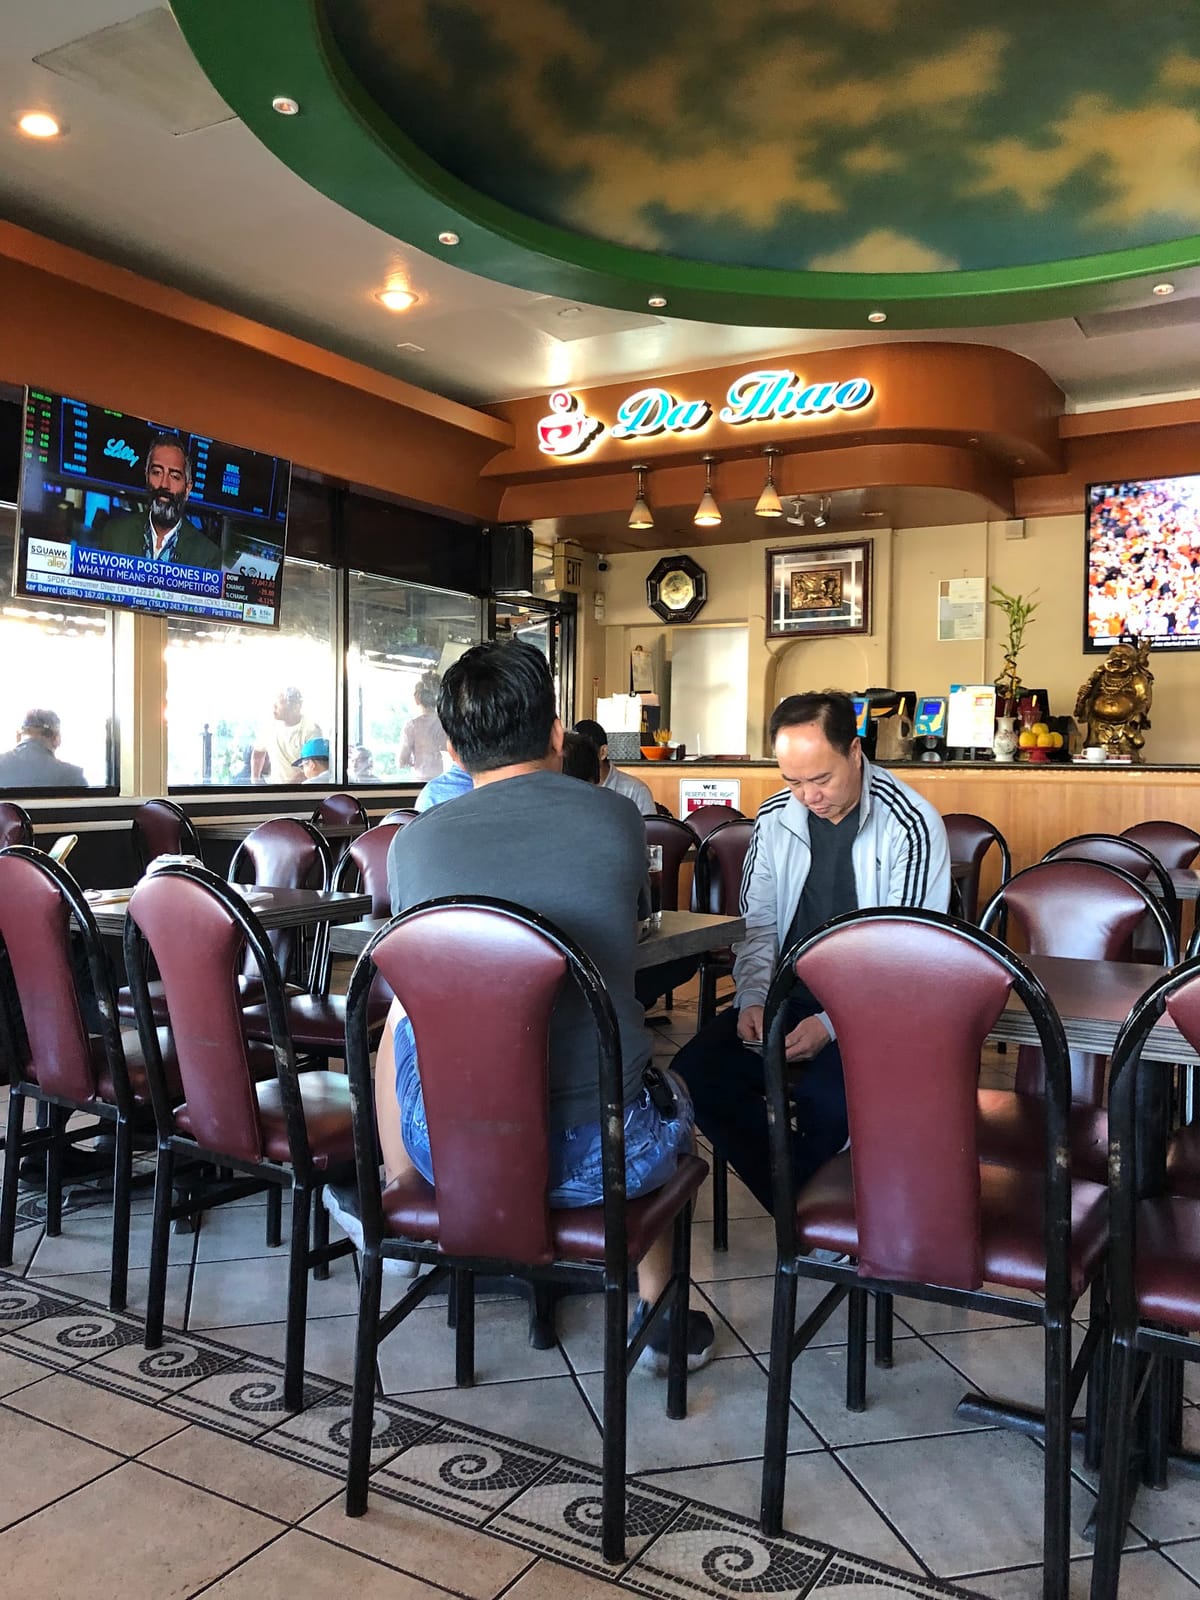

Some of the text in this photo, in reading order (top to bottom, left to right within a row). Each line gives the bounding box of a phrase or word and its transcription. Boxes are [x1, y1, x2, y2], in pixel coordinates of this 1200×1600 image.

[719, 369, 873, 424] Thao
[31, 545, 67, 557] SQUAWK
[47, 557, 67, 570] alley
[78, 549, 134, 570] WEWORK
[137, 562, 200, 581] POSTPONES
[202, 573, 220, 584] IPO
[38, 583, 58, 594] Barrel
[78, 563, 220, 594] WHAT IT MEANS FOR COMPETITORS
